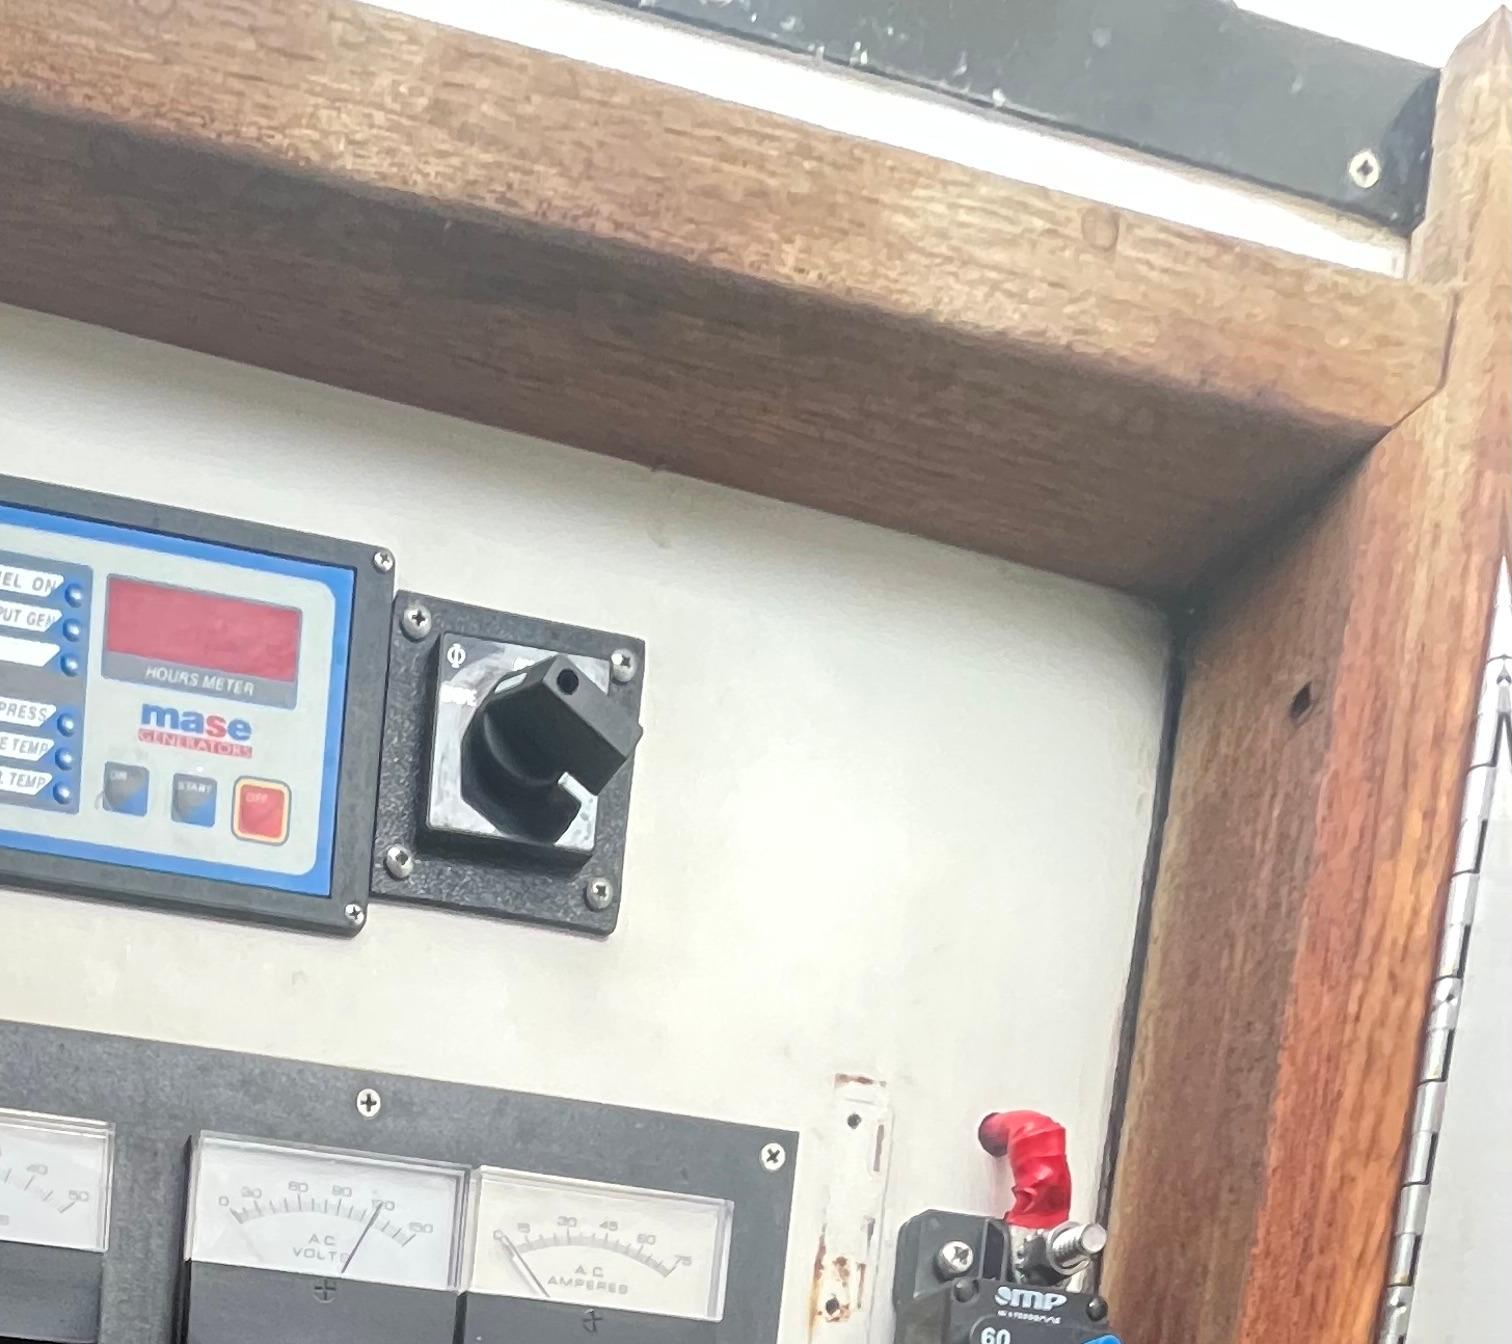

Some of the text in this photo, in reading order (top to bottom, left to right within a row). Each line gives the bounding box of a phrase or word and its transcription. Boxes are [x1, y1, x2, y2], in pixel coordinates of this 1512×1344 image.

[32, 577, 56, 593] ON
[145, 666, 254, 697] HOURS METER
[141, 703, 252, 741] mase
[12, 739, 49, 756] TEMP
[10, 772, 46, 790] TEMP
[177, 781, 213, 794] START
